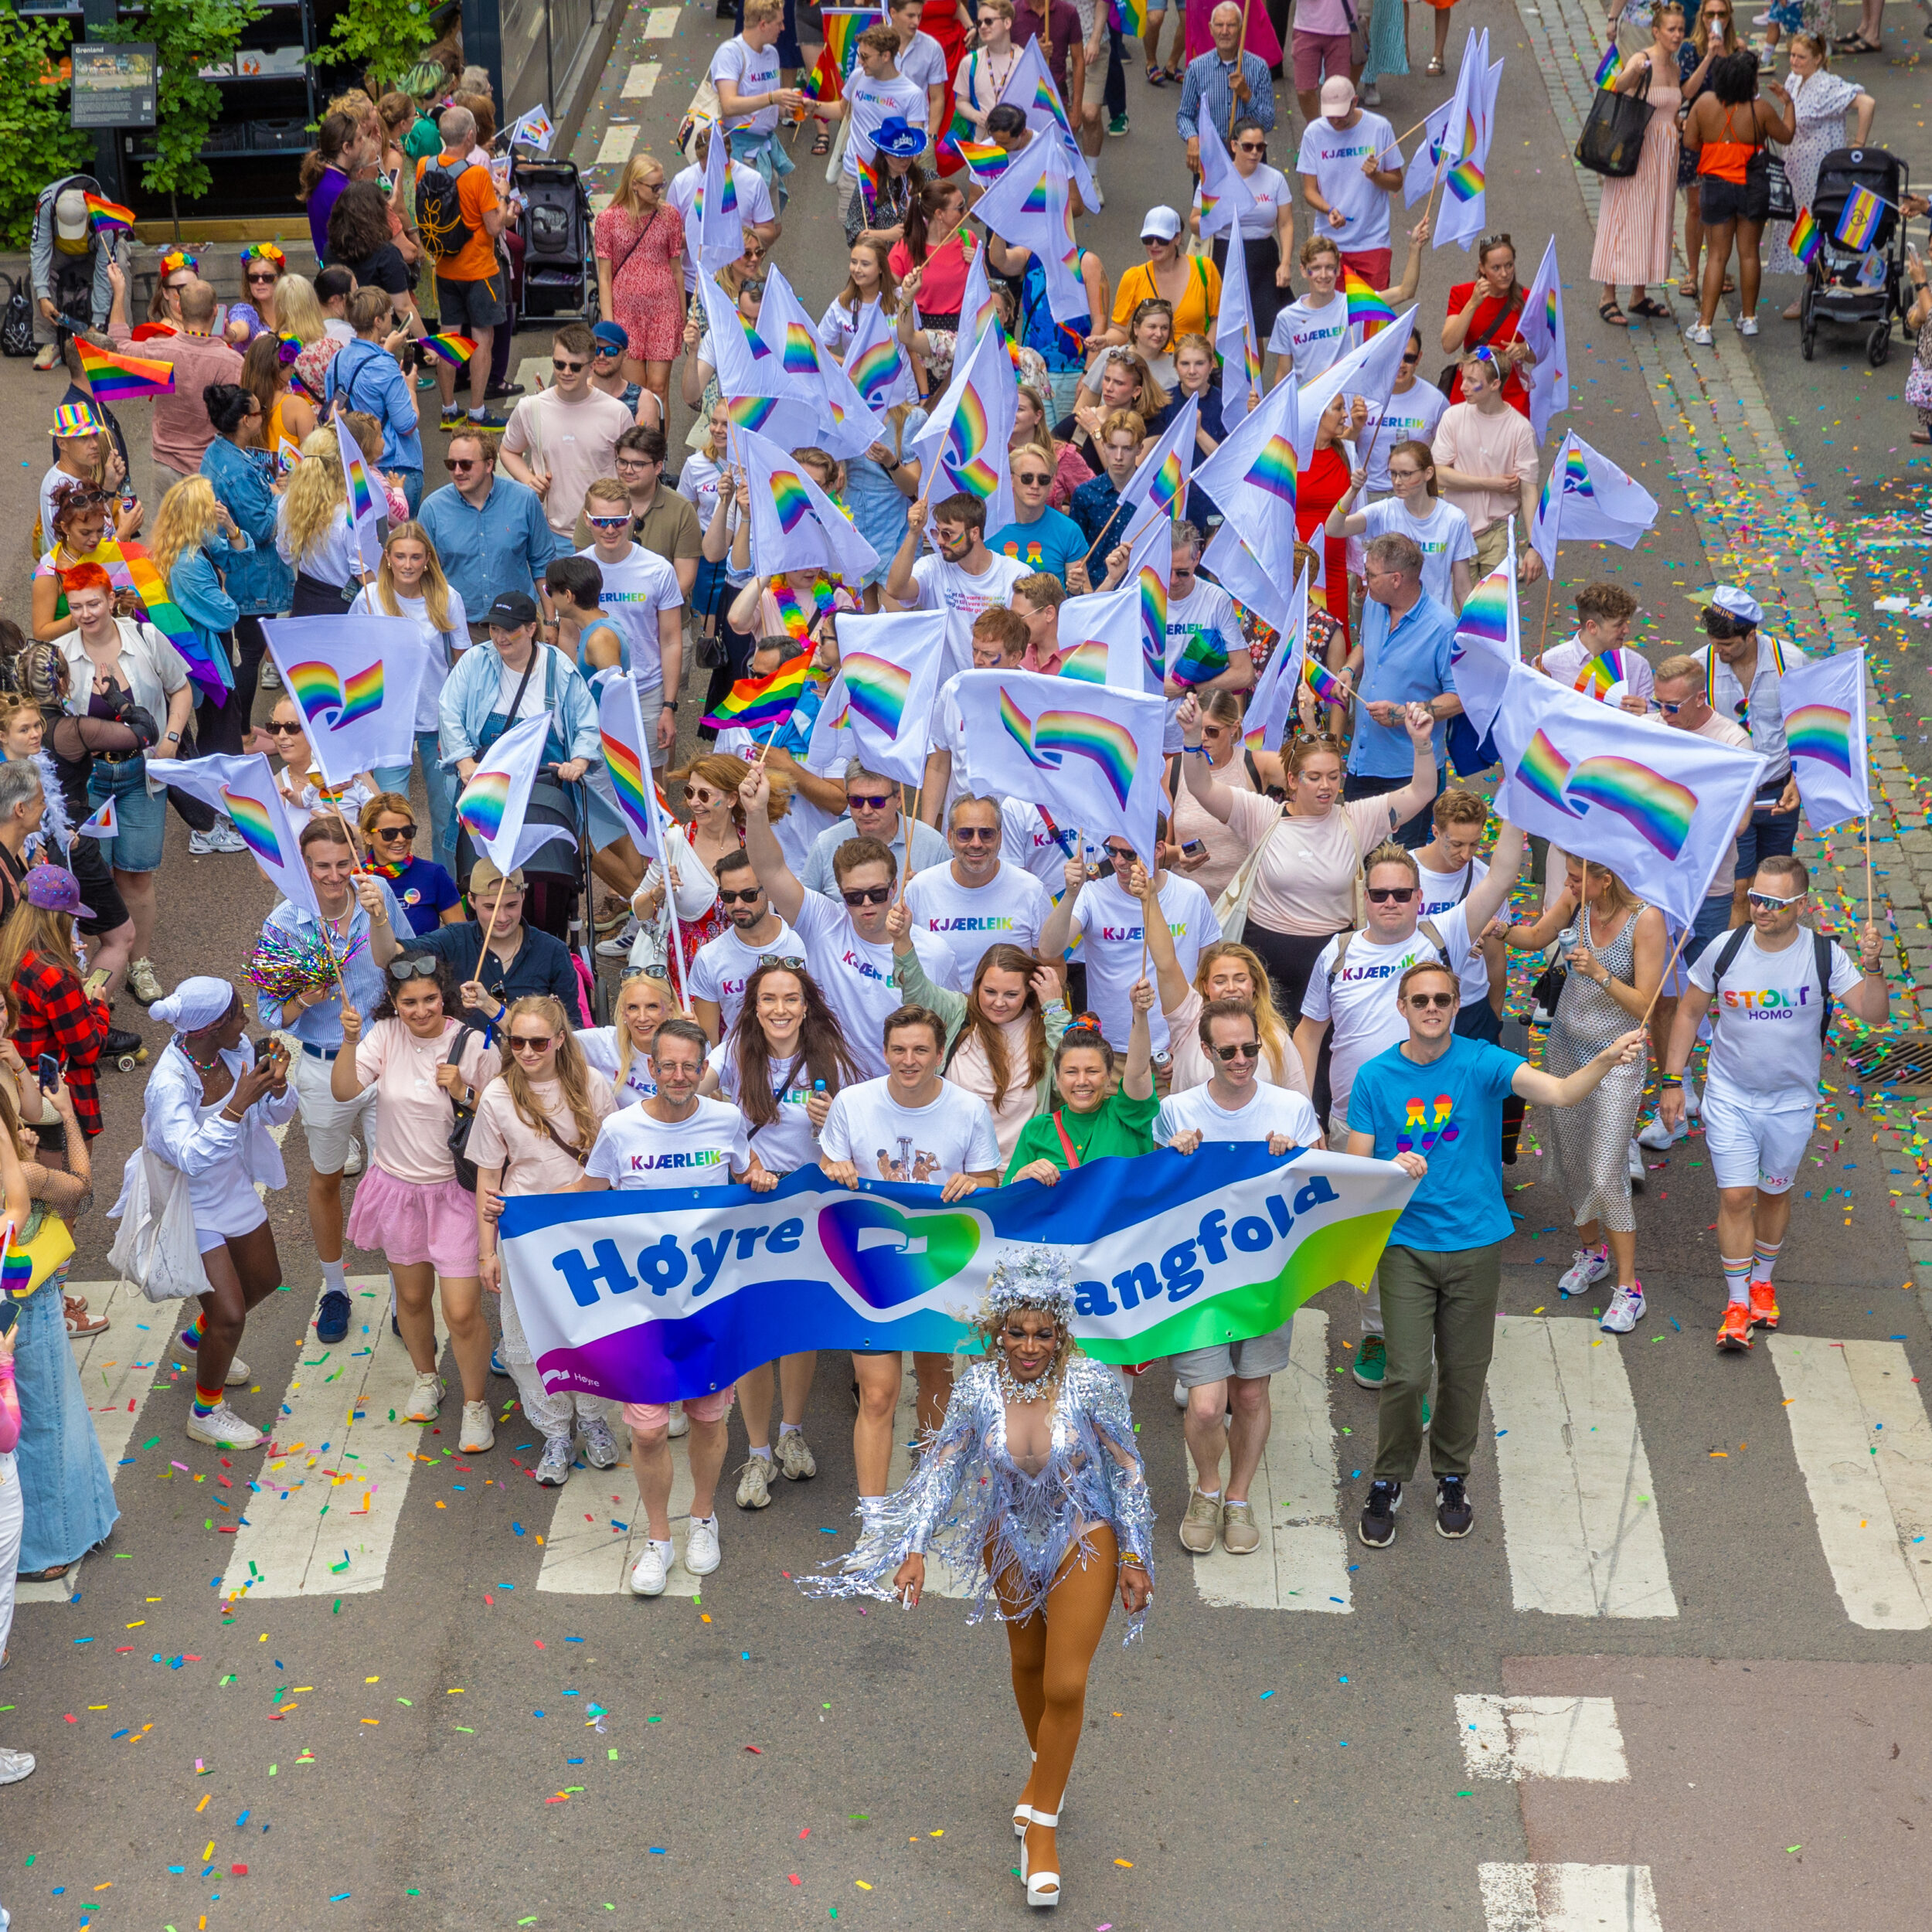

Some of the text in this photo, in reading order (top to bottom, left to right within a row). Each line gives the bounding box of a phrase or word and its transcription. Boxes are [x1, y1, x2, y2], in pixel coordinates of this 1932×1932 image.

[1367, 416, 1425, 430] JÆRLEIK
[929, 917, 1014, 932] KJÆRLEIK
[1103, 923, 1188, 940] KJÆIK
[1723, 985, 1810, 1009] STOLT
[1749, 1009, 1793, 1020] HOMO
[631, 1150, 722, 1171] KJÆRLEIK
[552, 1175, 1340, 1316] Høyre angfold
[574, 1372, 600, 1388] Høyre
